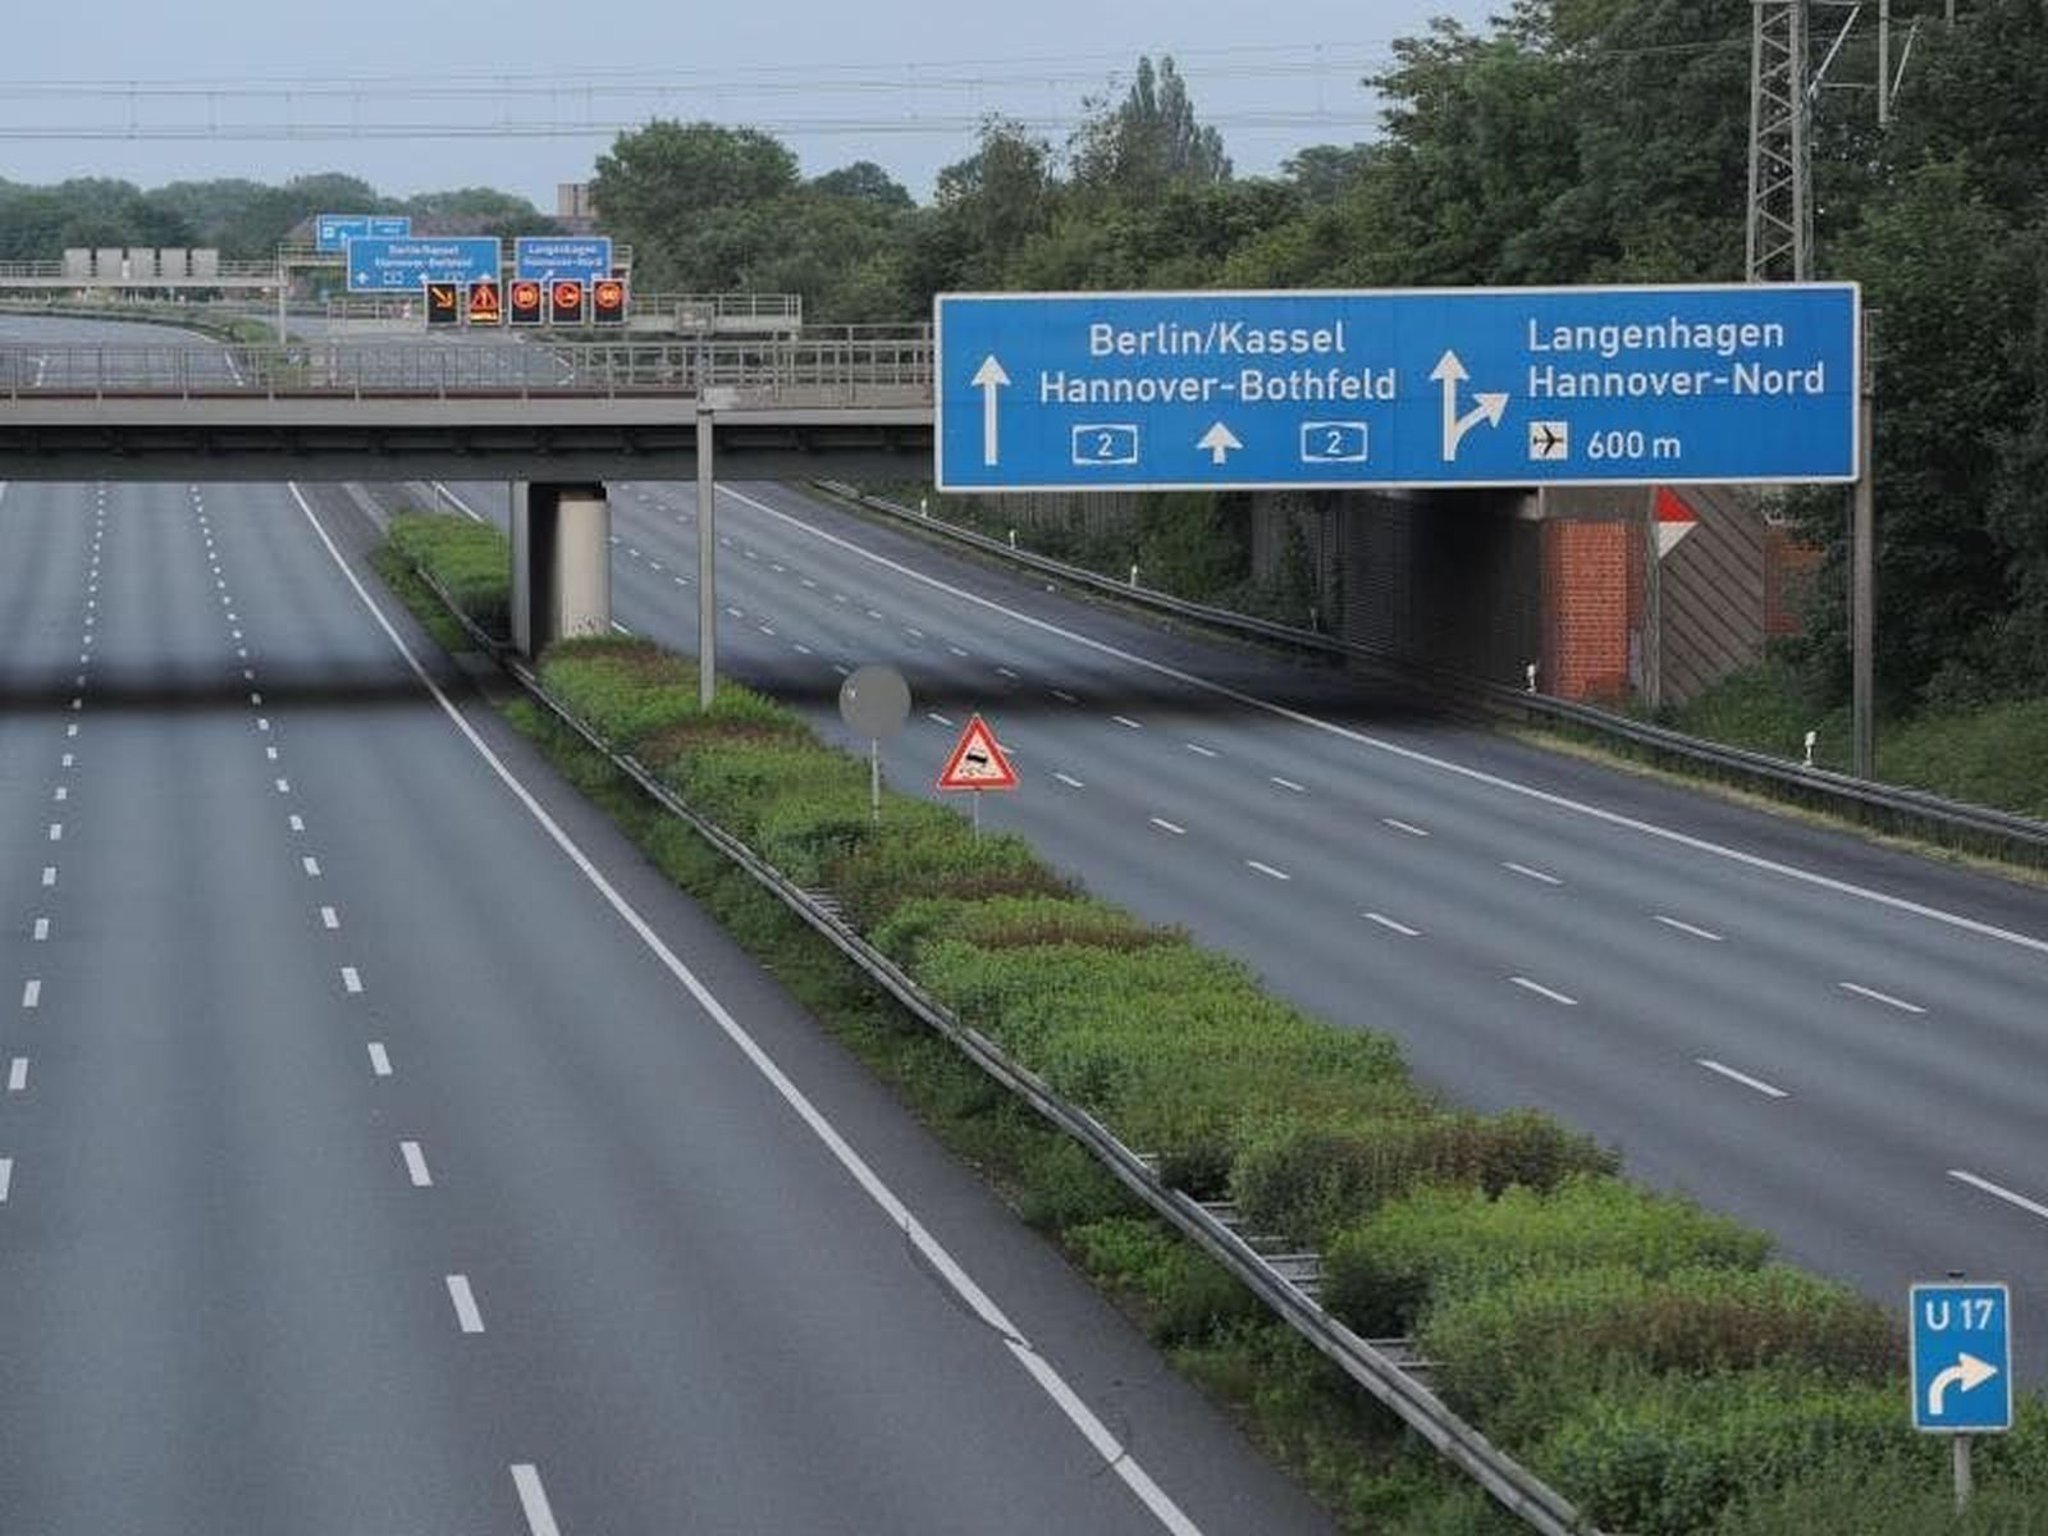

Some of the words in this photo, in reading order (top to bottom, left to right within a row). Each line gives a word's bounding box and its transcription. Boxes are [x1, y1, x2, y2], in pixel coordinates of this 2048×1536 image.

[1089, 319, 1346, 356] Berlin/Kassel
[1528, 316, 1784, 358] Langenhagen
[1040, 368, 1396, 403] Hannover-Bothfeld
[1528, 361, 1825, 398] Hannover-Nord
[1098, 433, 1113, 457] 2
[1326, 431, 1342, 455] 2
[1586, 430, 1645, 460] 600
[1652, 436, 1682, 459] m
[1925, 1300, 1950, 1331] U
[1960, 1298, 1994, 1330] 17
